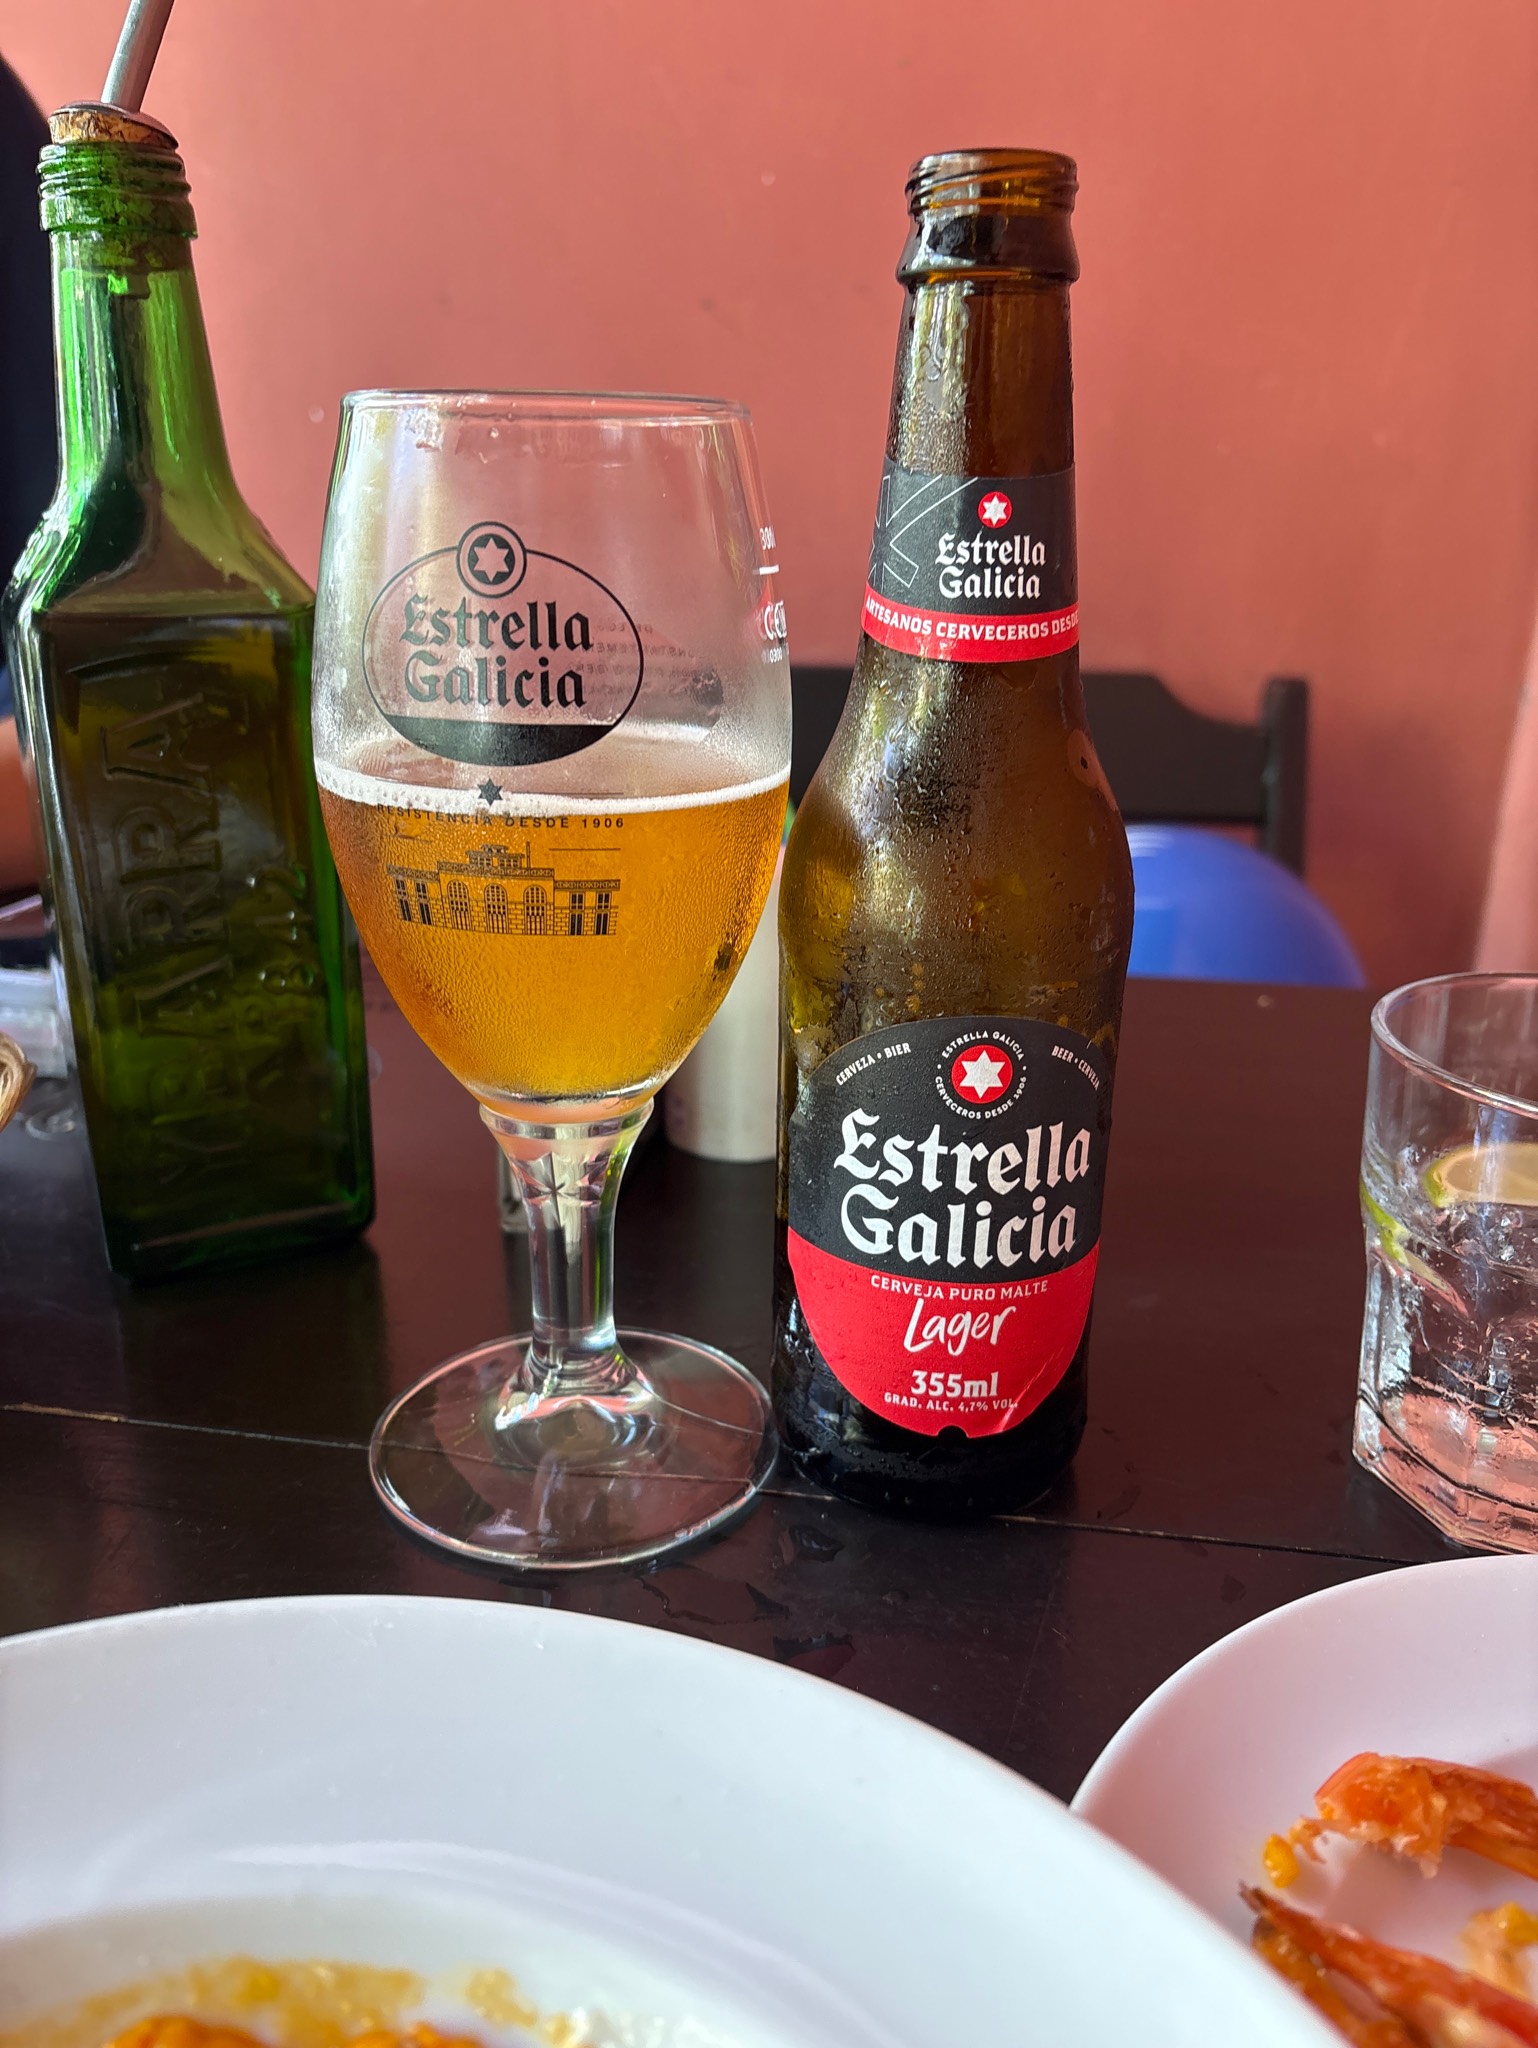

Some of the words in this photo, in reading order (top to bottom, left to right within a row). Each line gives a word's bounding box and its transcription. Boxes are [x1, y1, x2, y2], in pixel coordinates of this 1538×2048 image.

[935, 528, 1046, 566] Estrella
[939, 566, 1041, 599] Galicia
[400, 593, 593, 651] Estrella
[866, 596, 932, 635] ARTESANOS
[936, 621, 1049, 641] CERVECEROS
[404, 650, 587, 709] Galicia
[377, 803, 492, 826] RESISTENCIA
[505, 817, 569, 828] DESDE
[582, 817, 624, 829] 1906
[836, 1055, 876, 1086] CERVEZA
[884, 1042, 911, 1059] BIER
[941, 1030, 989, 1058] ESTRELLA
[993, 1031, 1025, 1061] GALICIA
[1051, 1045, 1074, 1063] BEER
[1078, 1059, 1101, 1090] CERVEJA
[935, 1076, 982, 1119] CERVECEROS
[985, 1100, 1014, 1119] DESDE
[1013, 1076, 1027, 1100] 1906
[834, 1108, 1090, 1196] Estrella
[841, 1183, 1077, 1269] Galicia
[871, 1275, 944, 1299] CERVEJA
[949, 1288, 996, 1300] PURO
[1000, 1280, 1048, 1300] MALTE
[904, 1298, 1016, 1356] Lager
[884, 1392, 922, 1408] GRAD.
[926, 1400, 954, 1412] ALC.
[958, 1401, 988, 1413] 4,7%
[911, 1370, 999, 1398] 355ml
